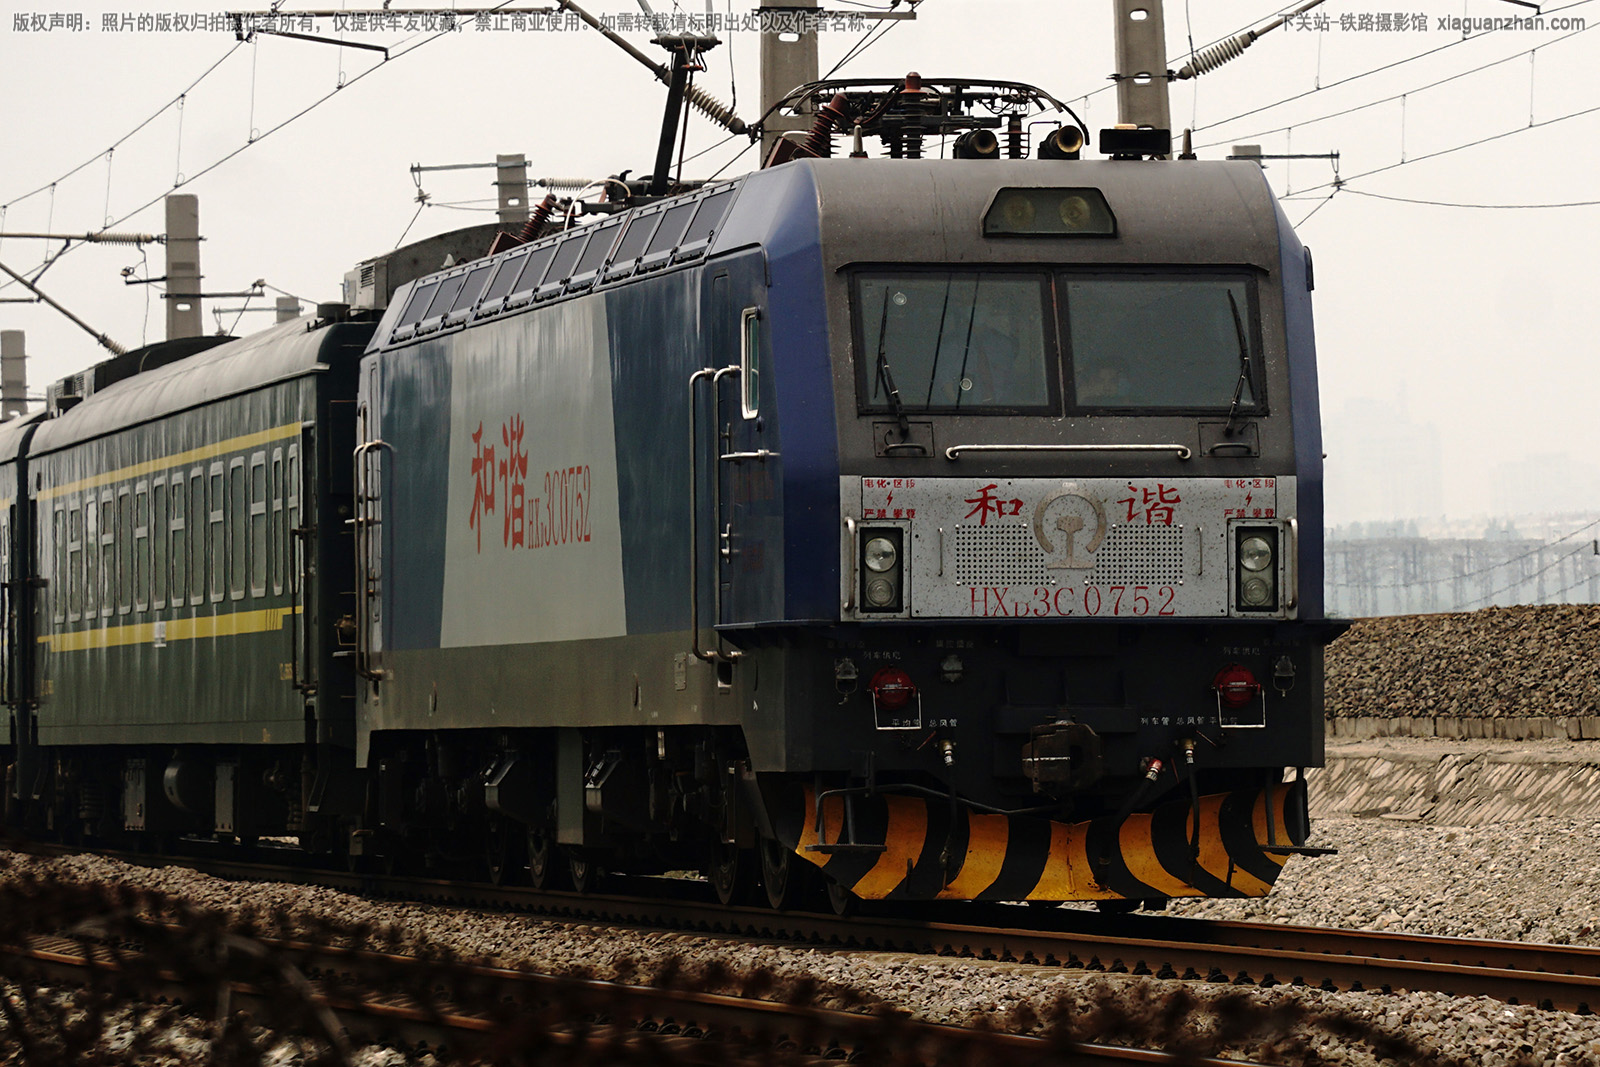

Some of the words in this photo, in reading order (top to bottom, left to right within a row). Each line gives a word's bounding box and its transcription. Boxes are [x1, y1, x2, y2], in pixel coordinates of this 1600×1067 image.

[470, 413, 528, 554] 和谐
[965, 484, 1024, 526] 和
[1117, 484, 1182, 526] 谐
